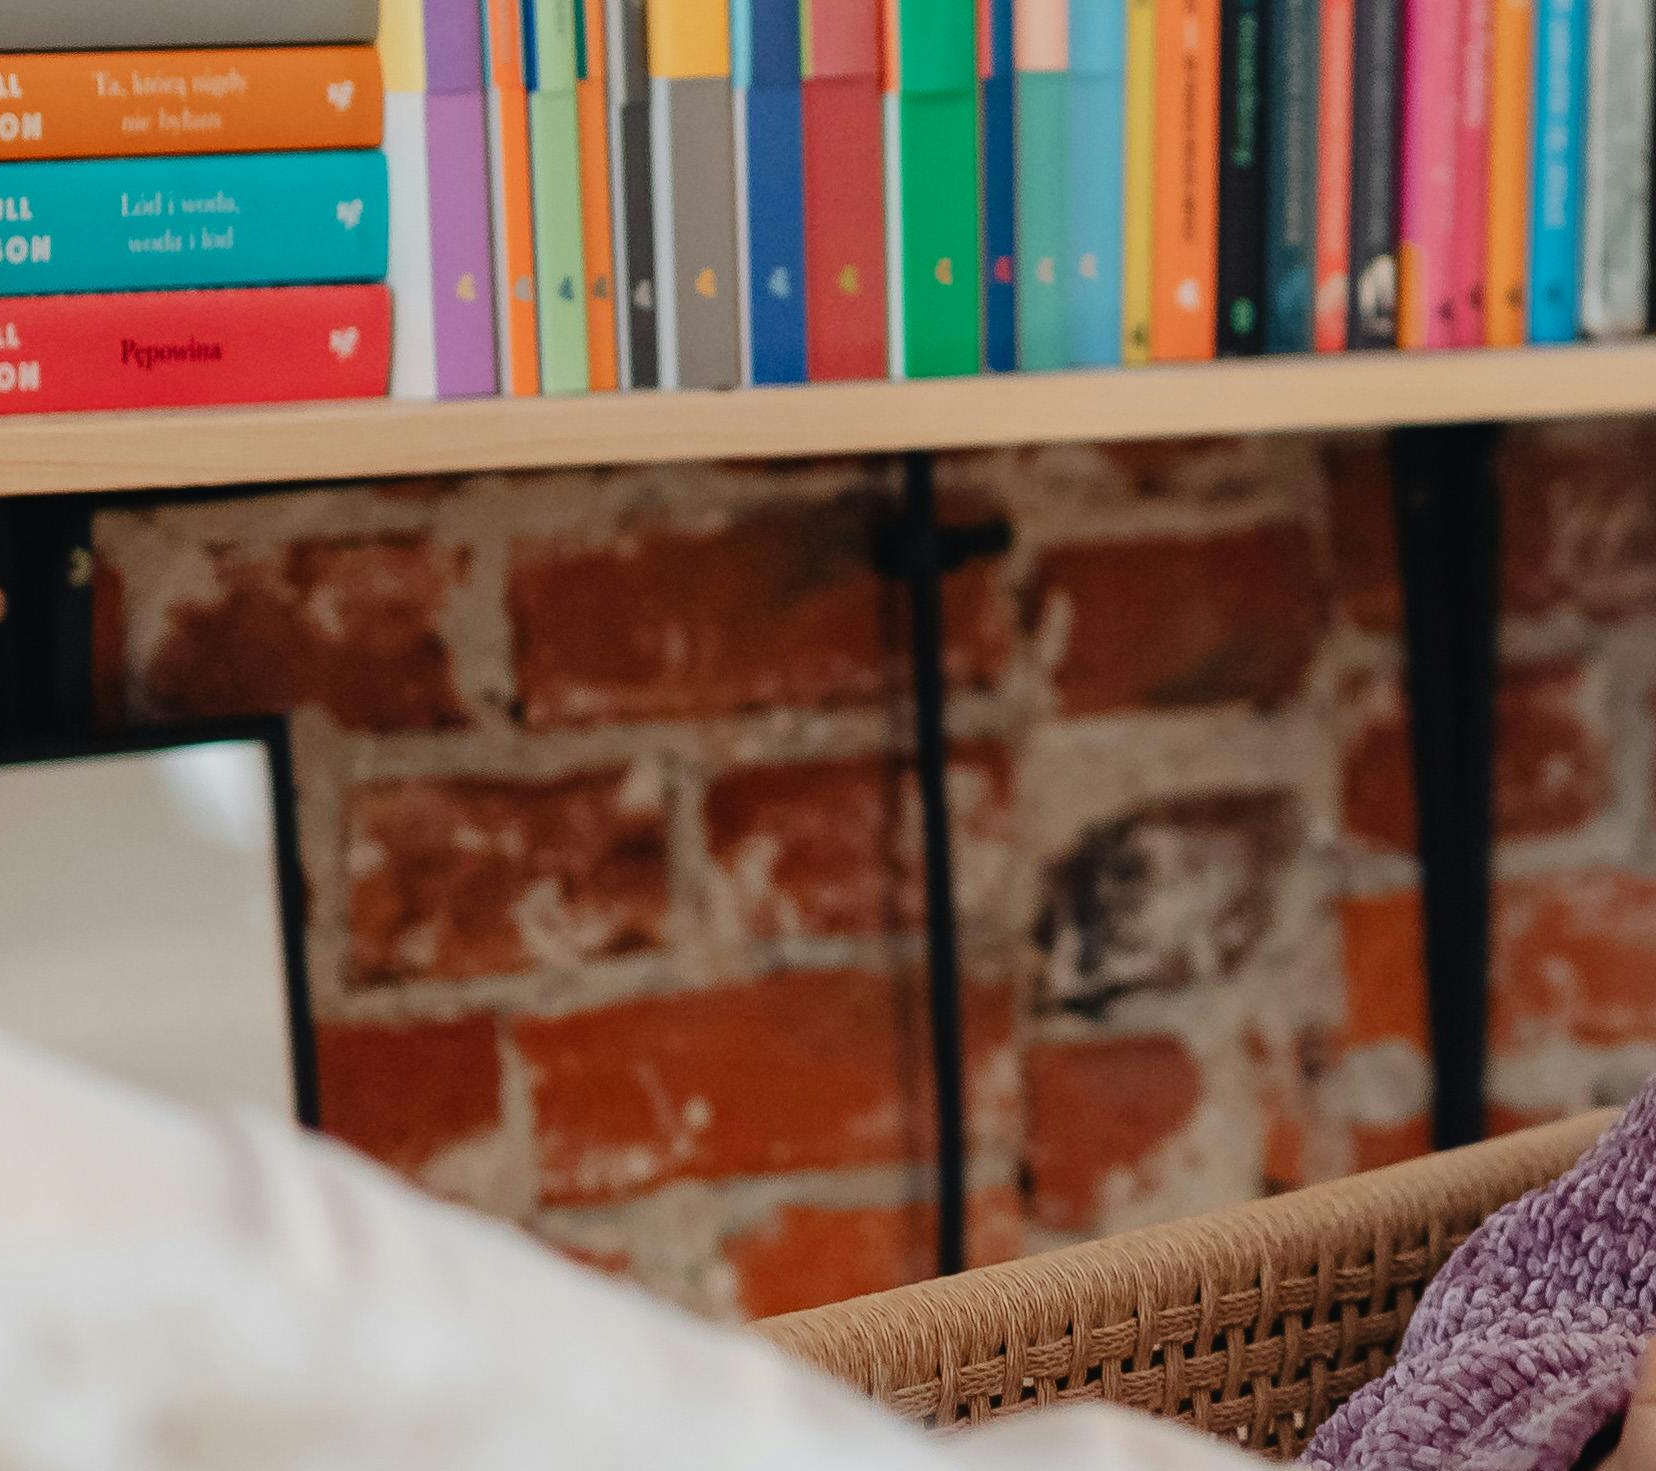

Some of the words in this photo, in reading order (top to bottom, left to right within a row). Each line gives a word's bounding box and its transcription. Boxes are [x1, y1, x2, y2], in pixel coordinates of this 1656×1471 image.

[168, 193, 175, 216] i
[189, 231, 196, 251] i
[120, 335, 222, 370] Pępowina
